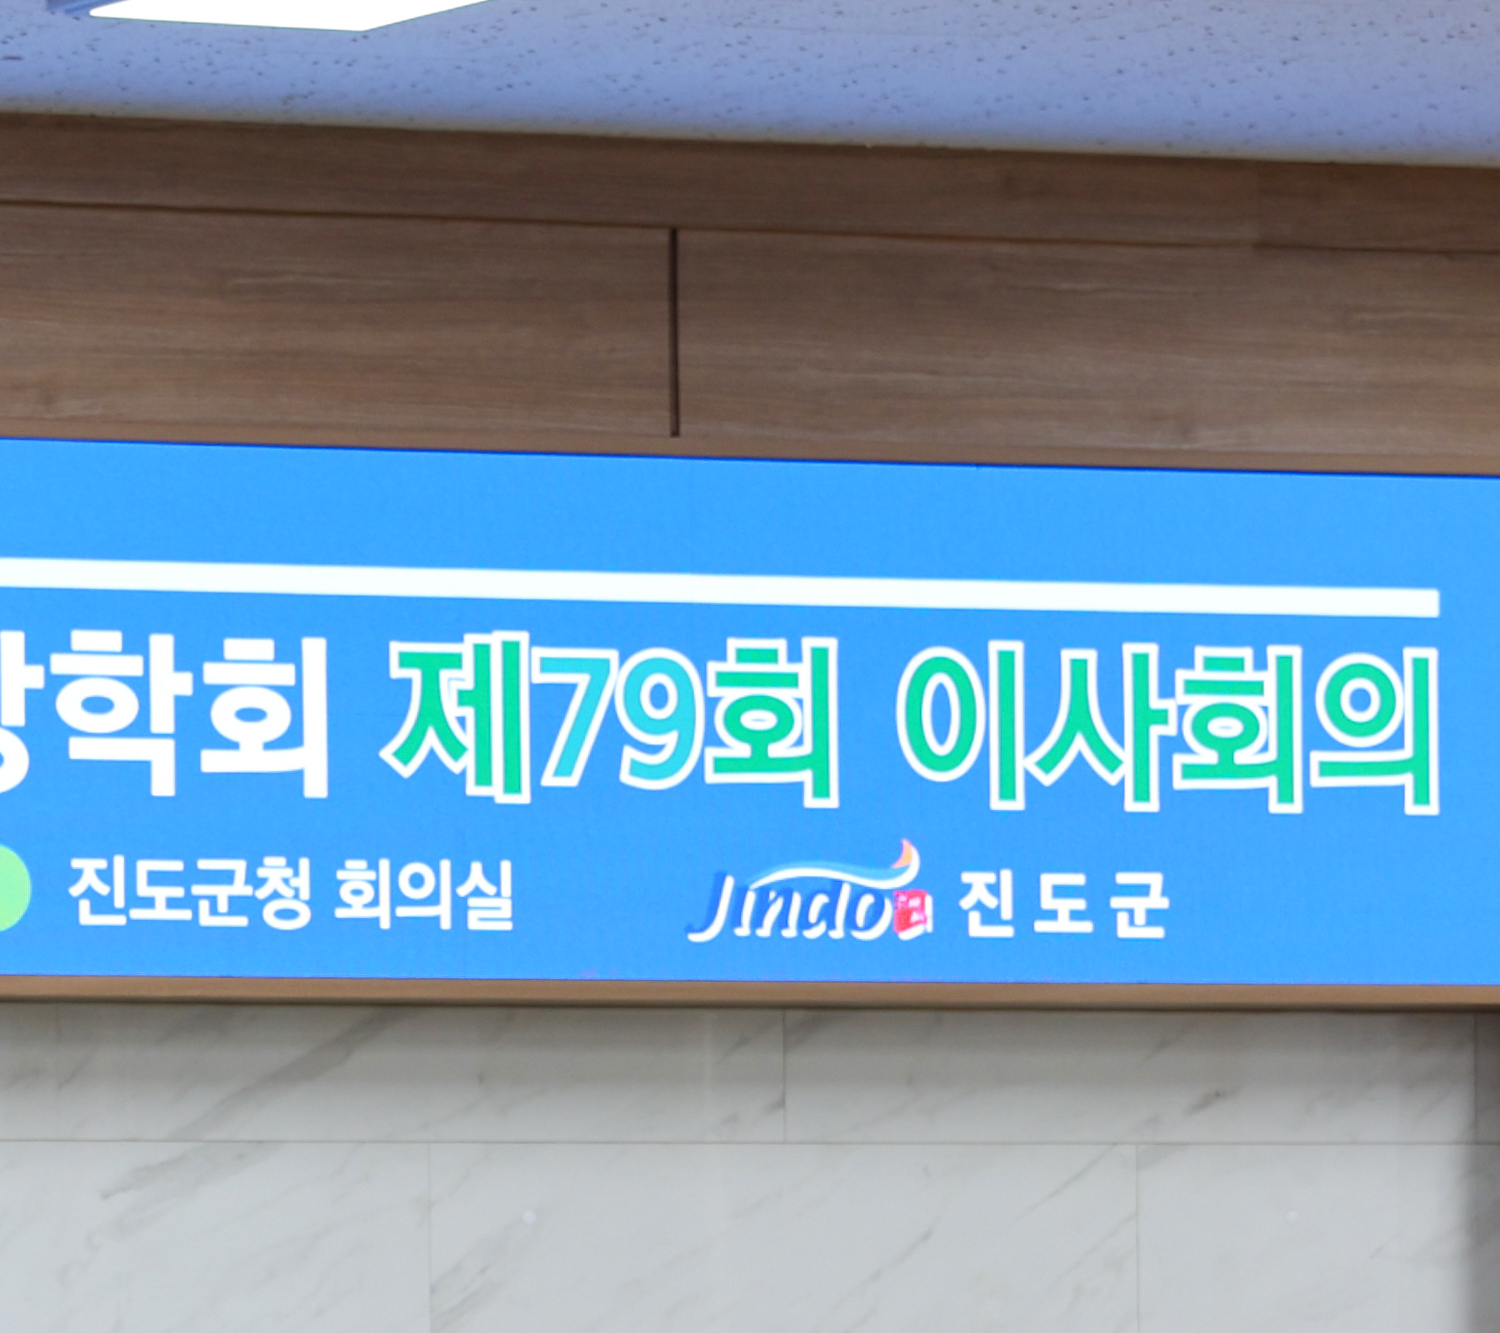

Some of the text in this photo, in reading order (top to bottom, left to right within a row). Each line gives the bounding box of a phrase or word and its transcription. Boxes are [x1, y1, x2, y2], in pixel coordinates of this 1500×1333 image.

[379, 630, 840, 808] 제79회
[896, 638, 1440, 816] 이사회의
[68, 855, 514, 931] 진도군청 회의실
